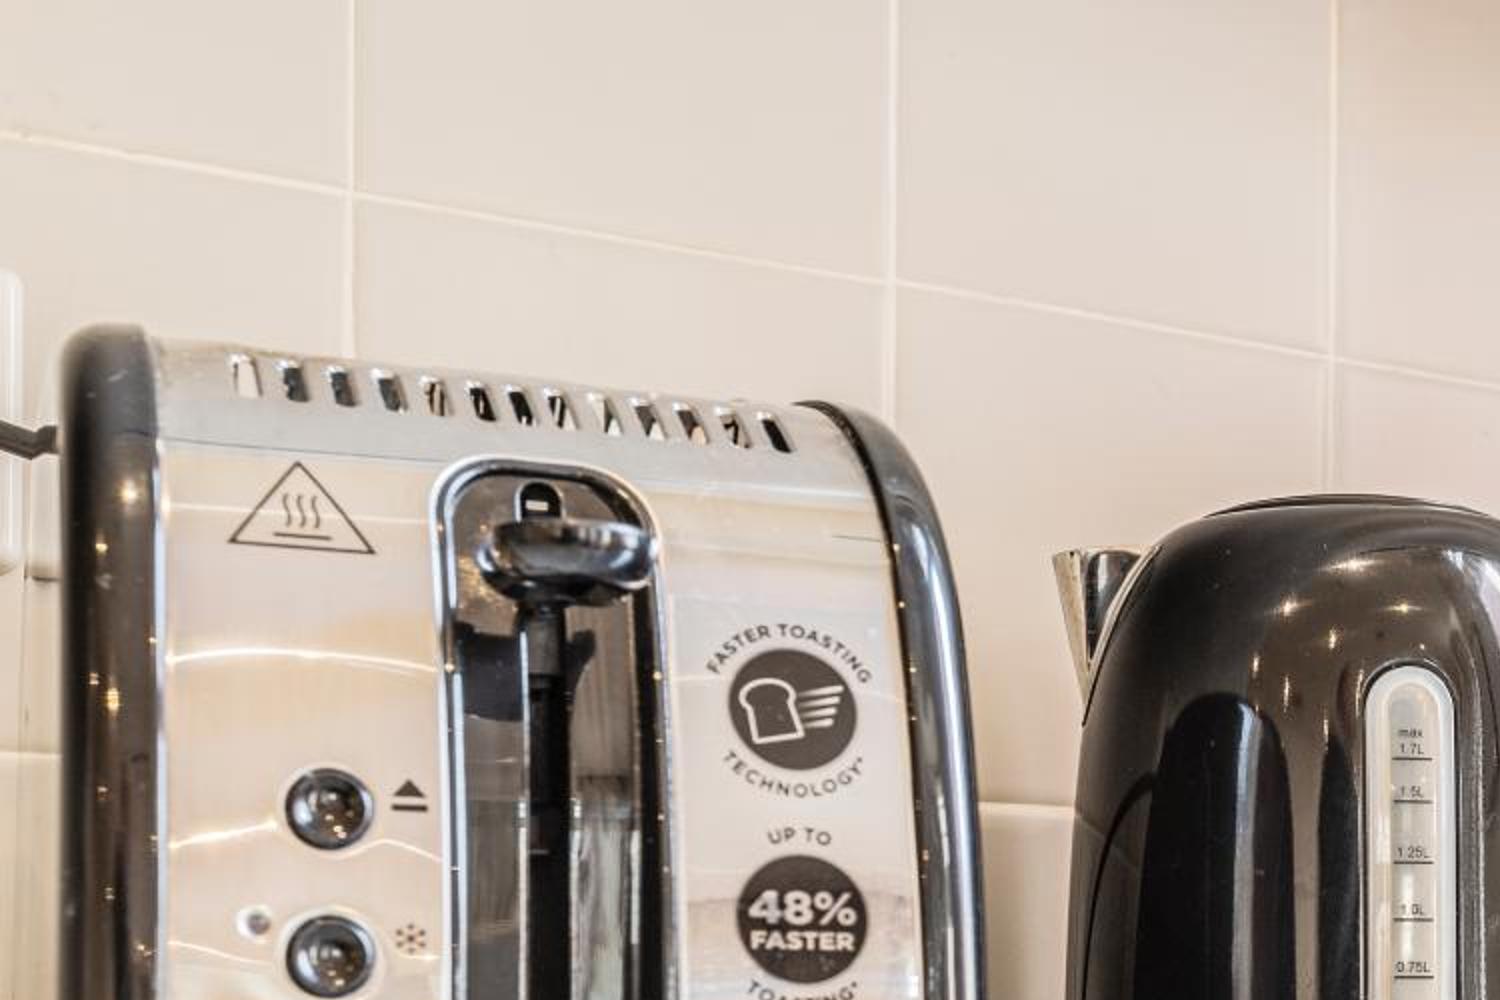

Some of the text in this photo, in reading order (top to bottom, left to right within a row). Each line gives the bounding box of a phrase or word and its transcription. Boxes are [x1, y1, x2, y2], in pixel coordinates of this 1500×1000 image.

[706, 623, 872, 684] FASTER TOASTING
[766, 826, 832, 846] UP TO
[747, 889, 858, 927] 48%
[750, 929, 855, 951] FASTER
